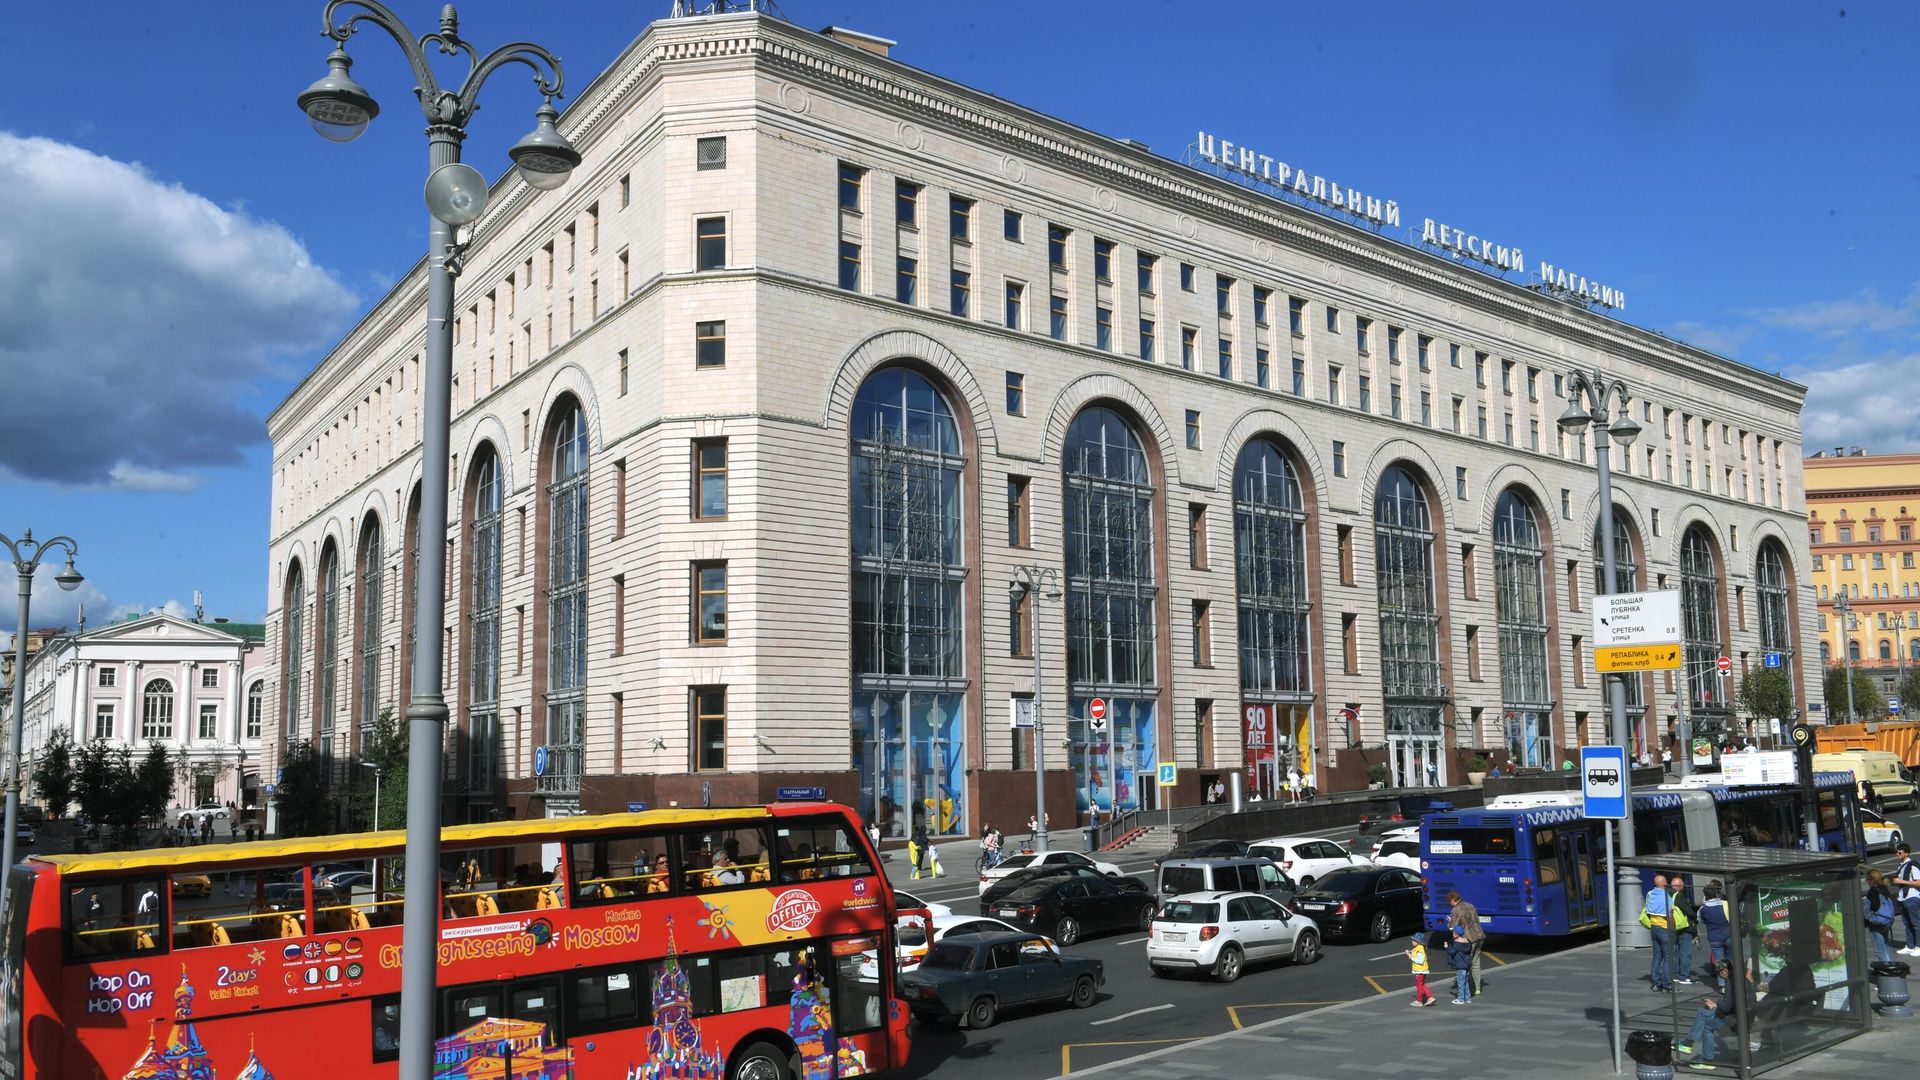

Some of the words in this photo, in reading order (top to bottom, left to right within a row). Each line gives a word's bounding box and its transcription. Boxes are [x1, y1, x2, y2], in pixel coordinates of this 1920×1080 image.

[1198, 131, 1400, 227] ЦЕНТРАЛЬНЫЙ
[1423, 218, 1524, 272] ДЕТСКИЙ
[1541, 261, 1635, 310] МАГАЗИН
[1610, 597, 1644, 605] БОЛЬШАЯ
[1610, 605, 1641, 614] ЛУБЯНКА
[1611, 626, 1645, 634] СРЕТЕНКА
[1610, 650, 1649, 658] РЕПАБЛИКА
[1635, 659, 1650, 667] клуб
[771, 902, 819, 927] OFFICIAL
[791, 914, 811, 928] TOUR
[89, 976, 123, 992] Hop
[127, 970, 151, 988] On
[88, 998, 122, 1014] Hop
[127, 991, 154, 1010] Off
